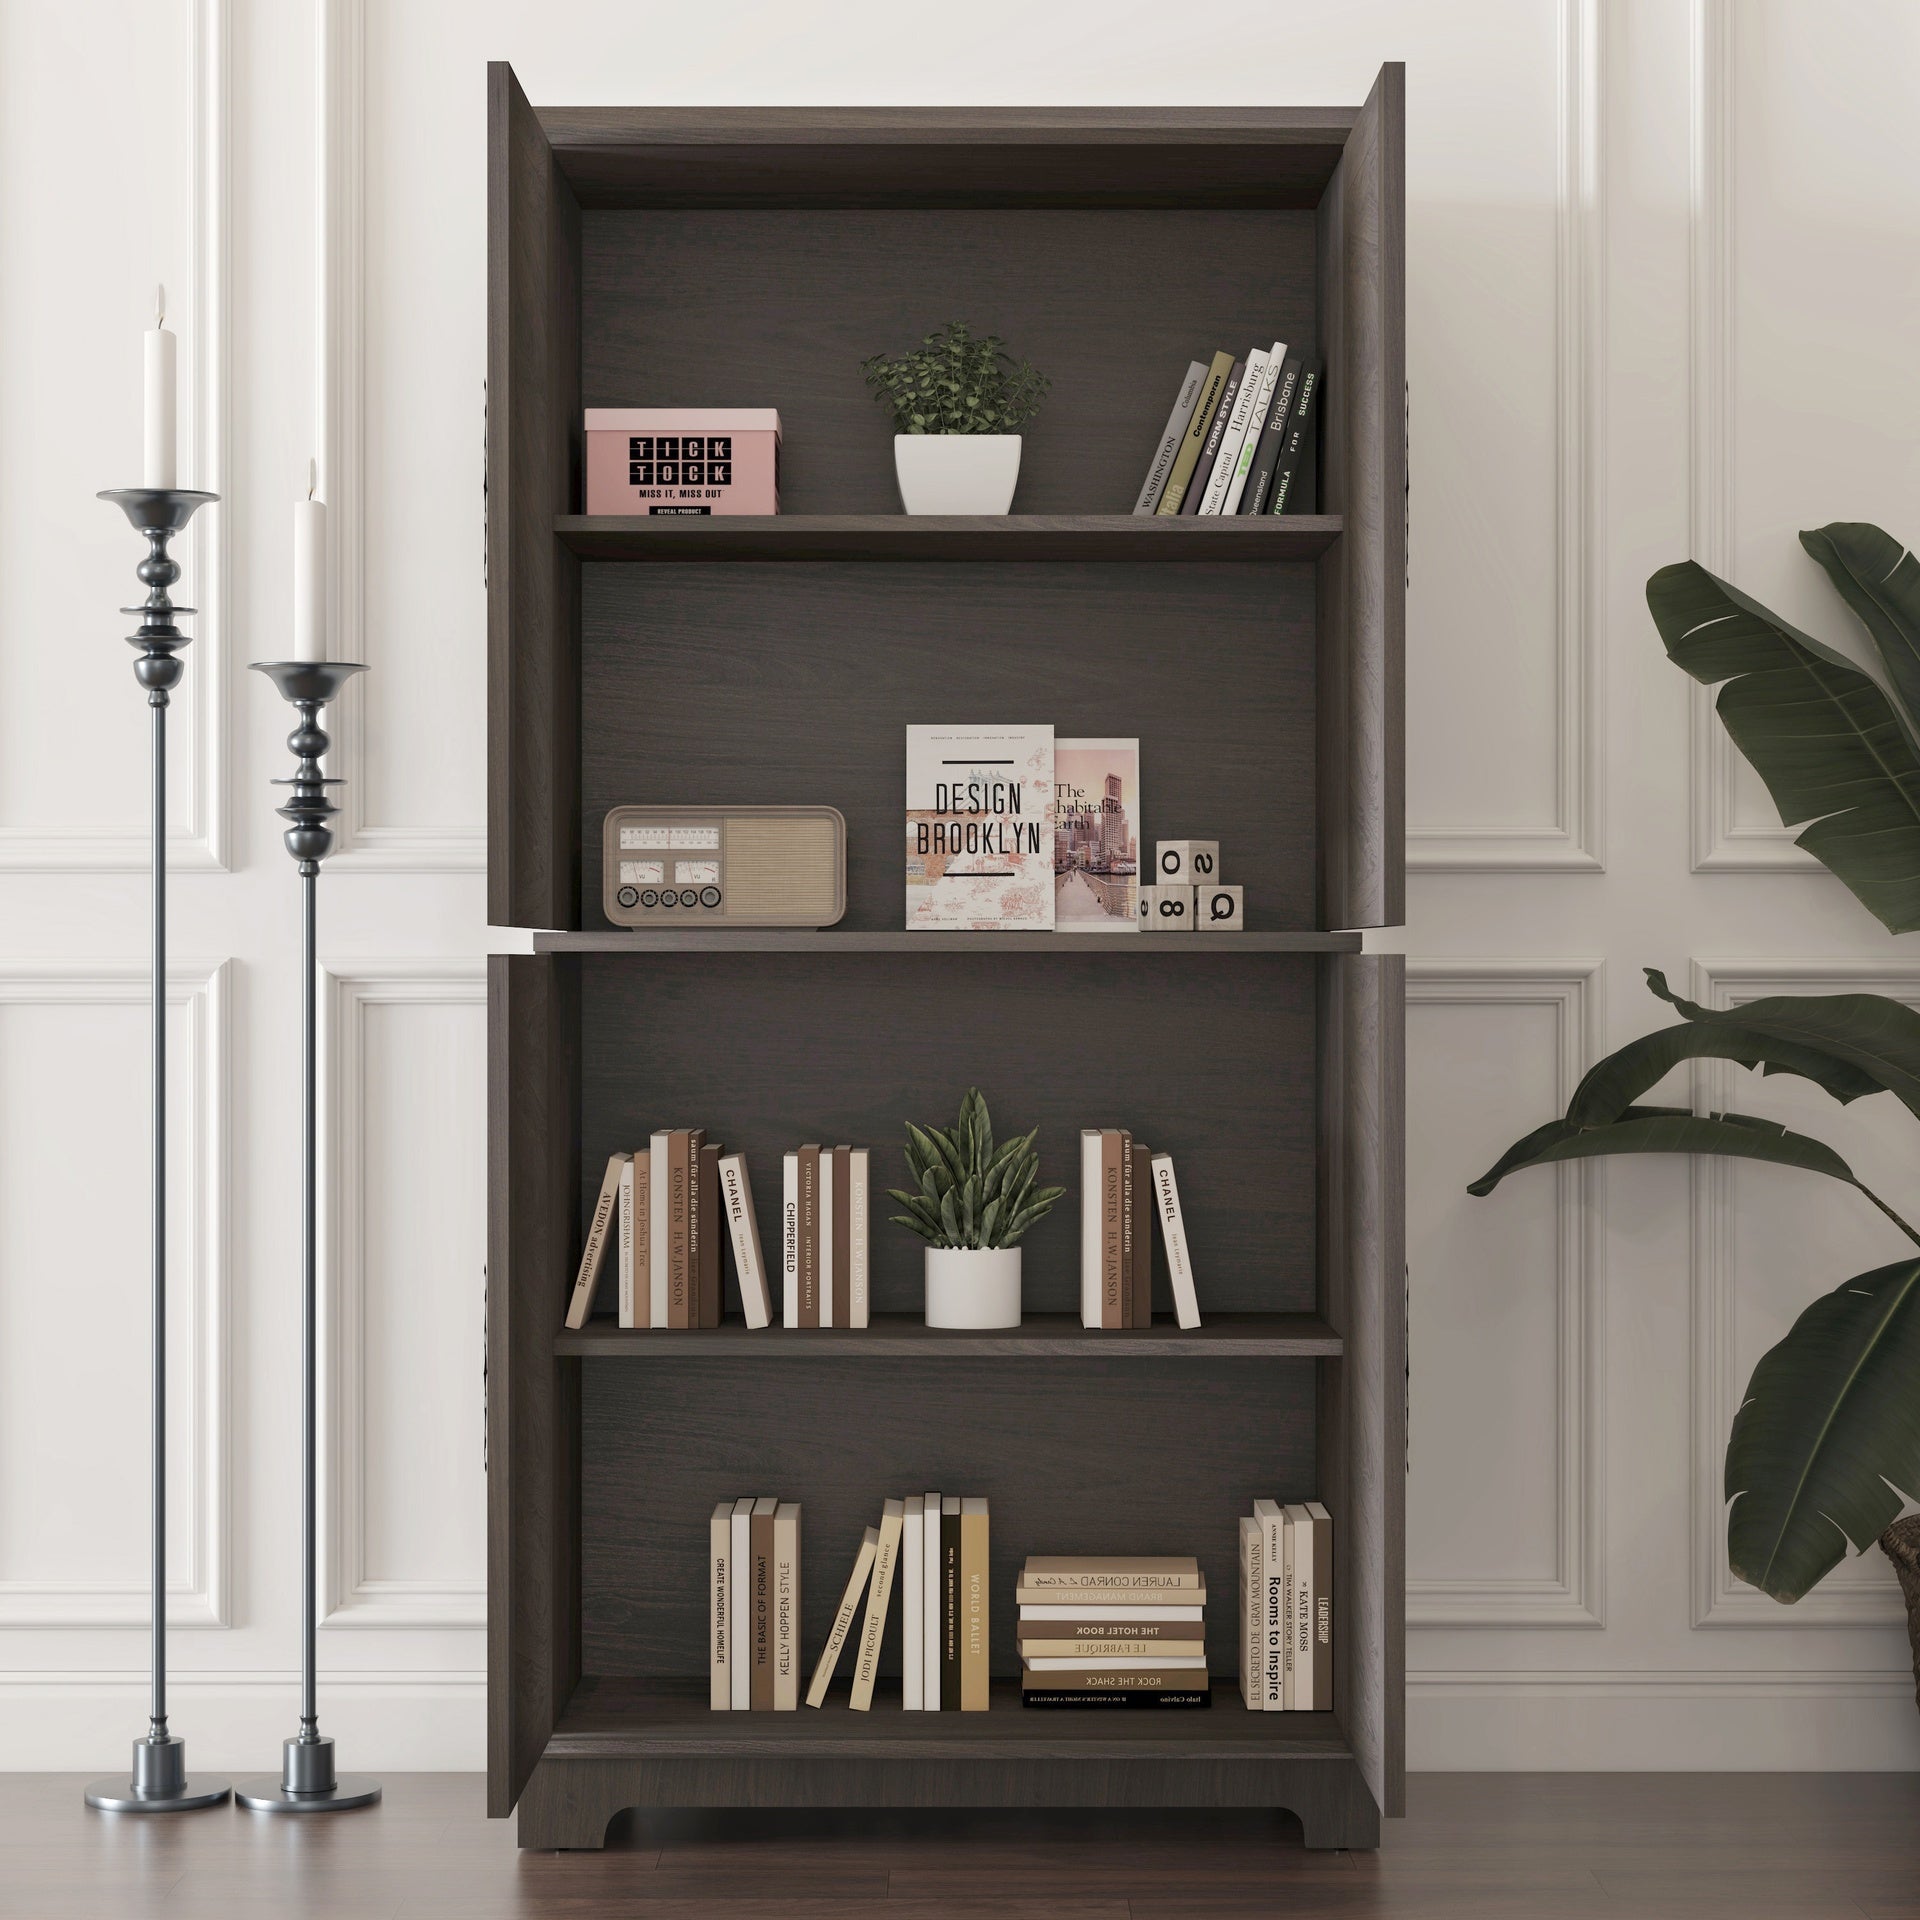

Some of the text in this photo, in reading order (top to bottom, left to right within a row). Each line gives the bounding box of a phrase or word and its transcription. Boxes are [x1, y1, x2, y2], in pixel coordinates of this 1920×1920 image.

[1193, 375, 1221, 438] Contemporan
[1206, 380, 1238, 456] FORM STYLE
[1230, 363, 1264, 432] Harrisburg
[1237, 365, 1279, 478] TED TALKS
[1270, 372, 1295, 431] Brisbane
[636, 441, 725, 457] TICK
[636, 465, 725, 482] TOCK
[1142, 379, 1197, 508] WASHINGTON Columbia
[1274, 373, 1315, 515] FORMULA FOR SUCCESS
[639, 489, 722, 499] MISS IT, MISS OUT
[1205, 452, 1233, 515] State Capital
[936, 783, 1021, 815] DESIGN
[1054, 783, 1085, 798] The
[917, 822, 1040, 854] BROOKLYN
[1160, 900, 1184, 917] 8
[638, 1169, 648, 1267] At Home in Joshua Tree
[673, 1167, 683, 1223] KONSTEN
[691, 1198, 699, 1212] die
[725, 1169, 742, 1223] CHANEL
[855, 1182, 864, 1231] KONSTEN
[1107, 1167, 1117, 1223] KONSTEN
[1125, 1198, 1133, 1212] die
[1159, 1169, 1176, 1223] CHANEL
[577, 1191, 611, 1287] AVEDON advertising
[786, 1202, 796, 1273] CHIPPERFIELD
[877, 1543, 891, 1597] second glance
[716, 1558, 724, 1664] CREATE WONDERFUL HOMELIFE
[757, 1555, 767, 1665] THE BASIC OF FORMAT
[780, 1562, 790, 1676] KELLY HOPPEN STYLE
[830, 1603, 854, 1652] SCHIELE
[970, 1574, 980, 1656] WORLD BALLET
[1251, 1544, 1260, 1701] EL SECRETO DE GRAY MOUNTAIN
[1265, 1577, 1282, 1700] Rooms to Inspire
[1299, 1591, 1309, 1652] KATE MOSS
[1318, 1597, 1329, 1644] LEADERSHIP
[860, 1614, 880, 1682] JODI PICOULT
